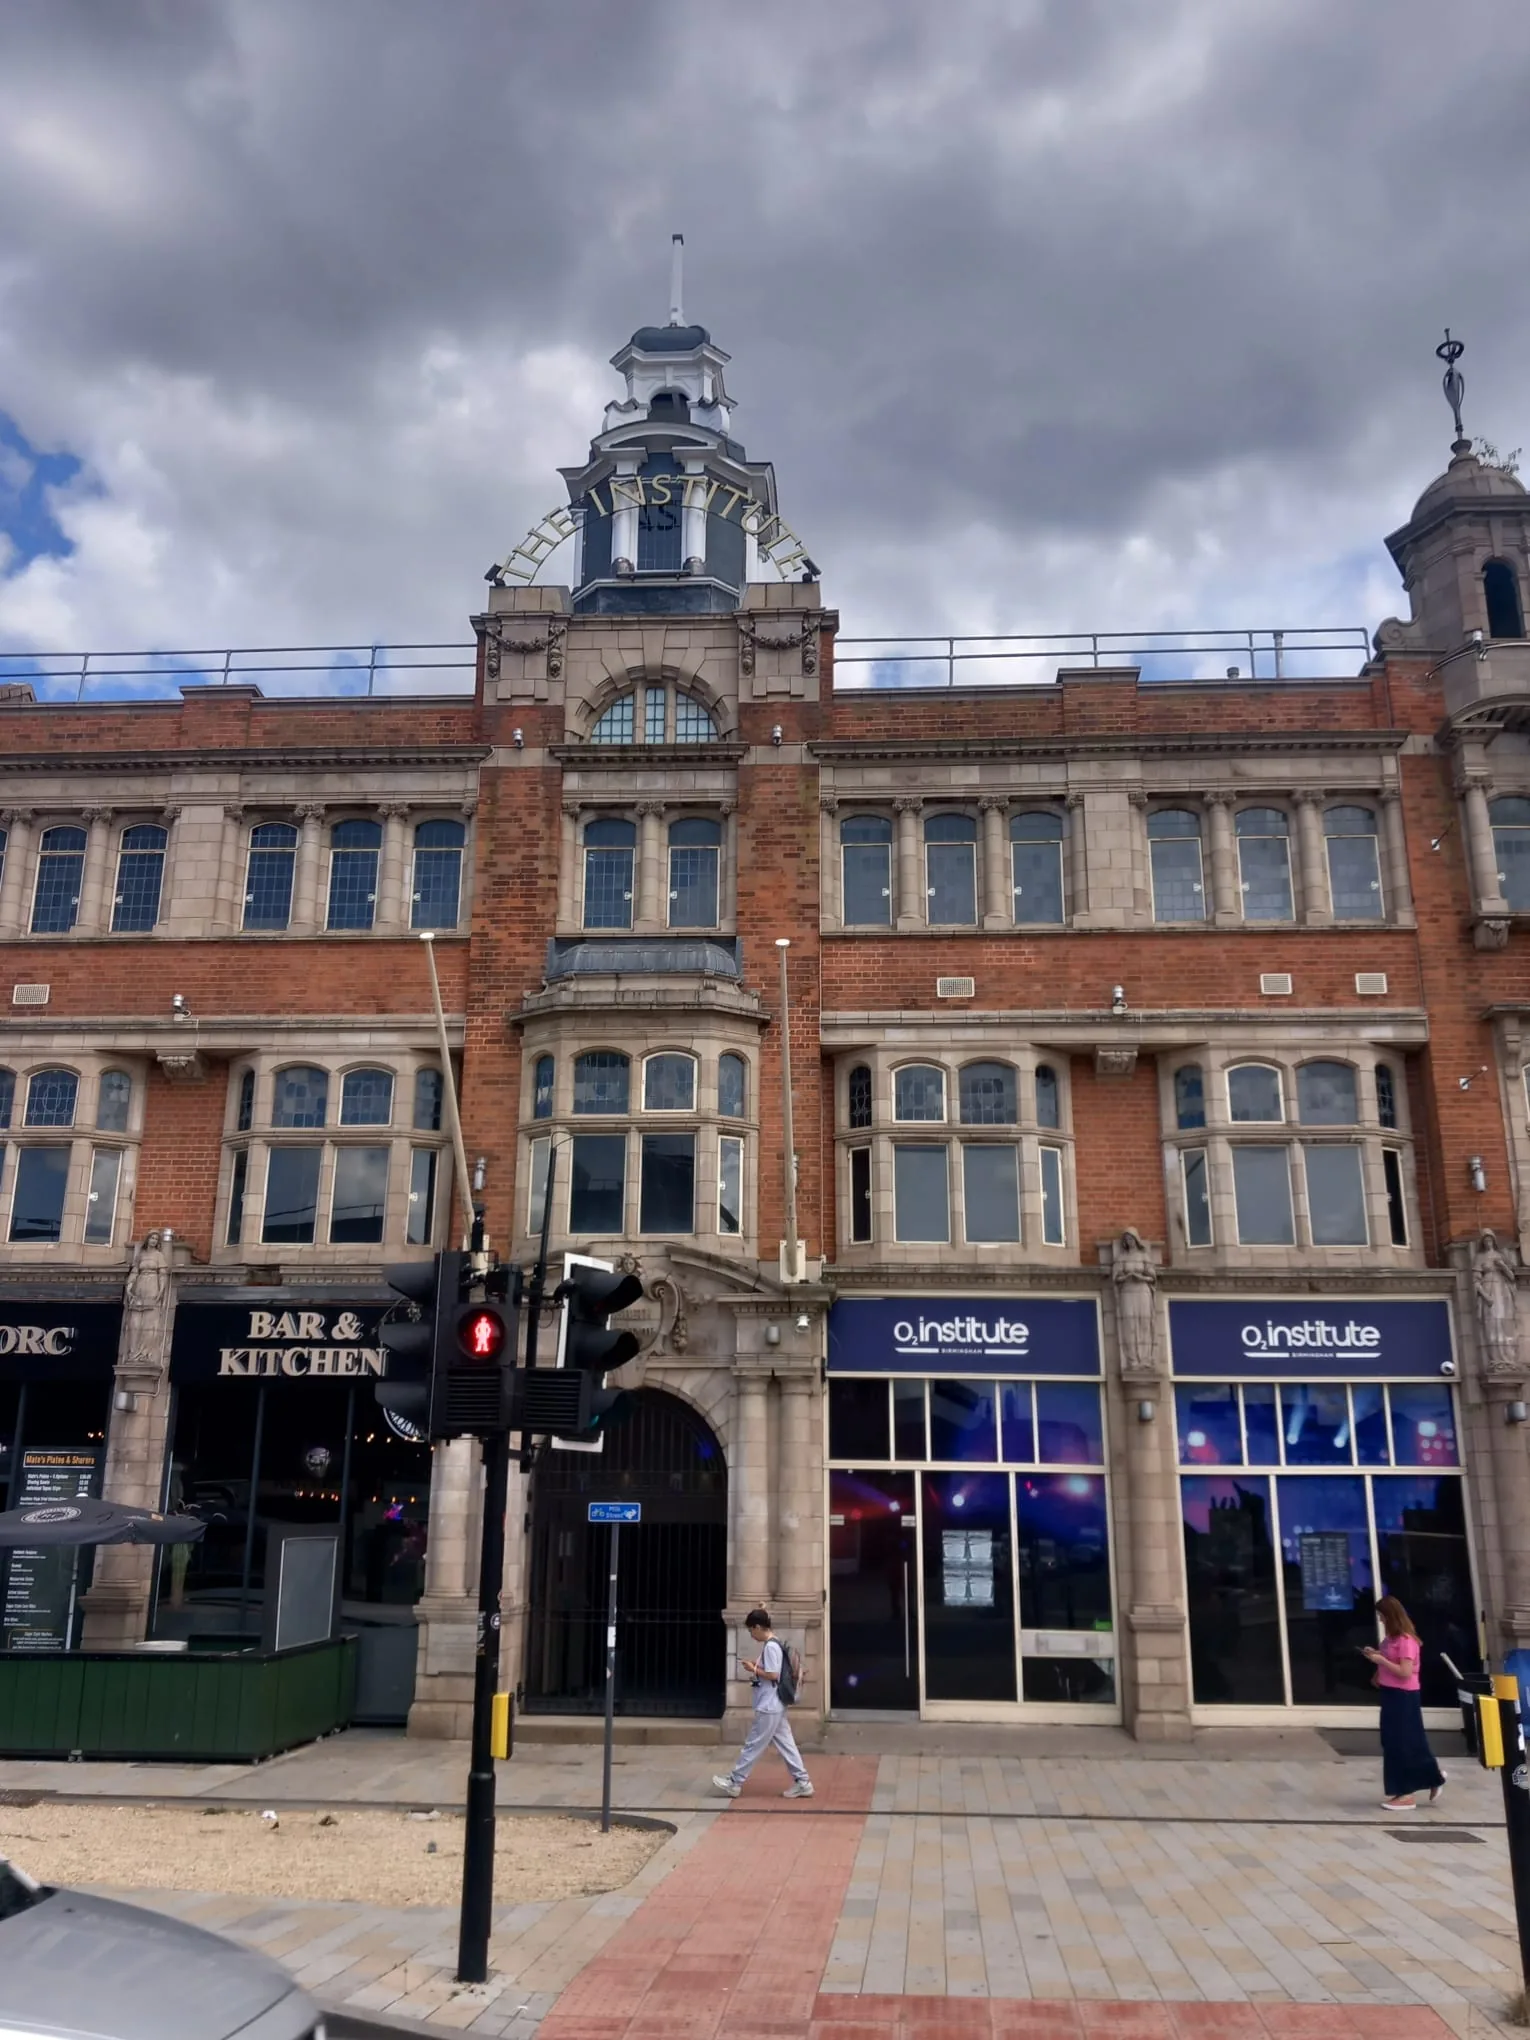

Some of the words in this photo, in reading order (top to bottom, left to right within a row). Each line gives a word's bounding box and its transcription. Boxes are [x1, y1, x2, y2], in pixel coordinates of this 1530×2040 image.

[501, 507, 577, 580] THE
[589, 474, 809, 579] INSTITUTE
[247, 1311, 328, 1341] BAR
[331, 1311, 363, 1341] &
[217, 1347, 388, 1377] KITCHEN
